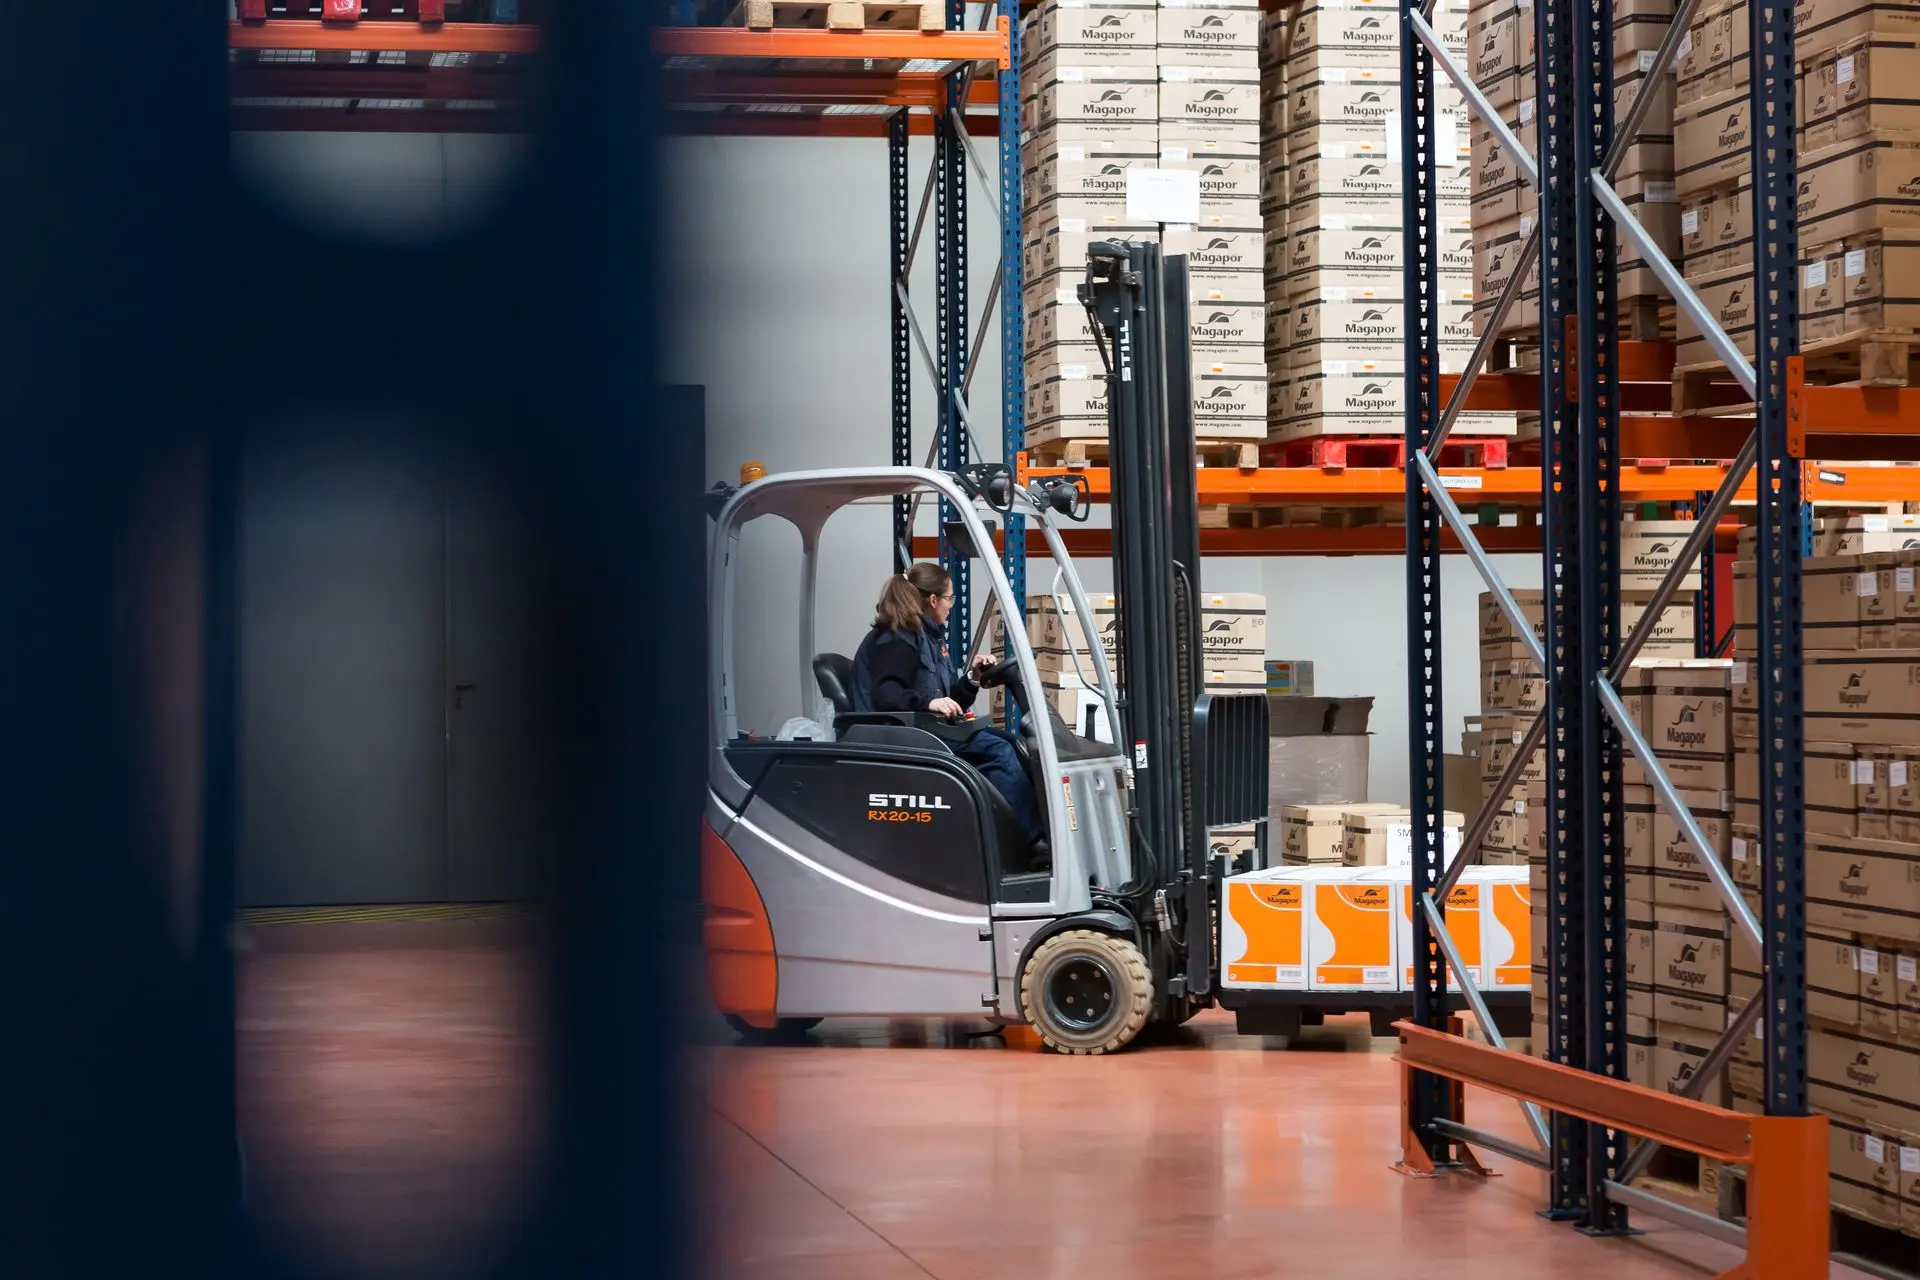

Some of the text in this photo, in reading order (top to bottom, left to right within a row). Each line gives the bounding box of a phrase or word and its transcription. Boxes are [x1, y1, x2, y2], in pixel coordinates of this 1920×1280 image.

[1082, 29, 1135, 42] Magapor
[1183, 29, 1237, 43] Magapor
[1343, 31, 1393, 43] Magapor
[1476, 54, 1503, 76] Magapor
[1083, 104, 1136, 117] Magapor
[1185, 103, 1238, 116] Magapor
[1718, 129, 1747, 149] Magapor
[1479, 166, 1506, 187] Magapor
[1082, 178, 1127, 191] Magap
[1199, 179, 1238, 191] gapor
[1190, 251, 1242, 265] Magapor
[1344, 250, 1395, 264] Magapor
[1720, 305, 1749, 325] Magapor
[1191, 325, 1243, 338] Magapor
[1345, 323, 1396, 337] Magapor
[1120, 319, 1132, 382] STILL
[1194, 399, 1246, 413] Magapor
[1345, 397, 1396, 410] Magapor
[1634, 556, 1676, 568] Magap
[1202, 635, 1245, 647] agapor
[1667, 727, 1707, 749] Magapor
[868, 793, 951, 810] STILL
[867, 810, 932, 823] RX20-15
[1267, 896, 1299, 905] Magapor
[1353, 897, 1386, 906] Magapor
[1447, 897, 1476, 905] agapor
[1668, 964, 1706, 988] Magapor
